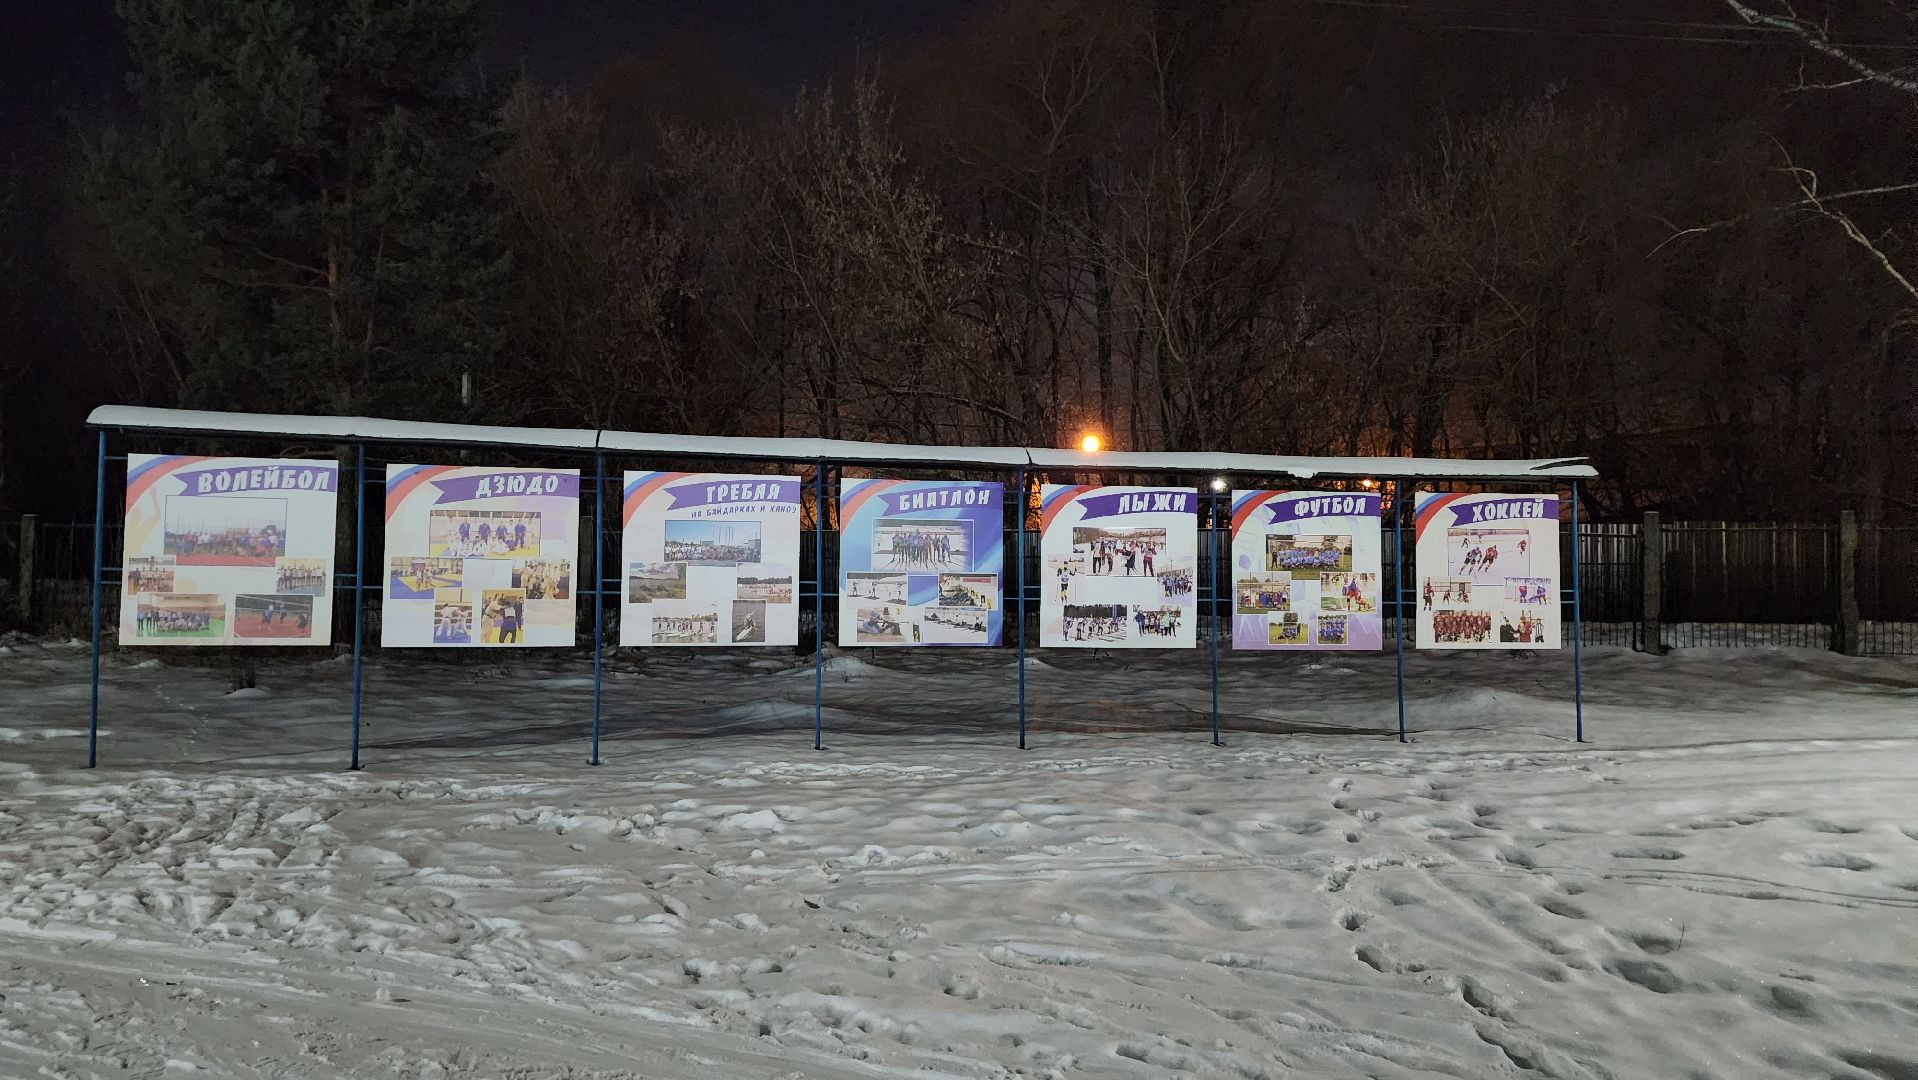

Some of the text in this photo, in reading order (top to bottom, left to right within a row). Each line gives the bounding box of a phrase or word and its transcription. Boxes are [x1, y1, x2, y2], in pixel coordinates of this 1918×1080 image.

[197, 465, 330, 493] ВОЛЕЙБОЛ
[475, 474, 559, 499] ДЗЮДО
[706, 483, 781, 503] ГРЕБЛЯ
[899, 488, 990, 511] БИАТЛОН
[1118, 493, 1187, 514] ЛЫЖИ
[691, 510, 702, 518] НА
[706, 505, 756, 516] БАЙДАРКАХ
[769, 505, 797, 513] КАНОЭ
[1294, 496, 1366, 517] ФУТБОЛ
[1472, 498, 1544, 522] ХОККЕЙ
